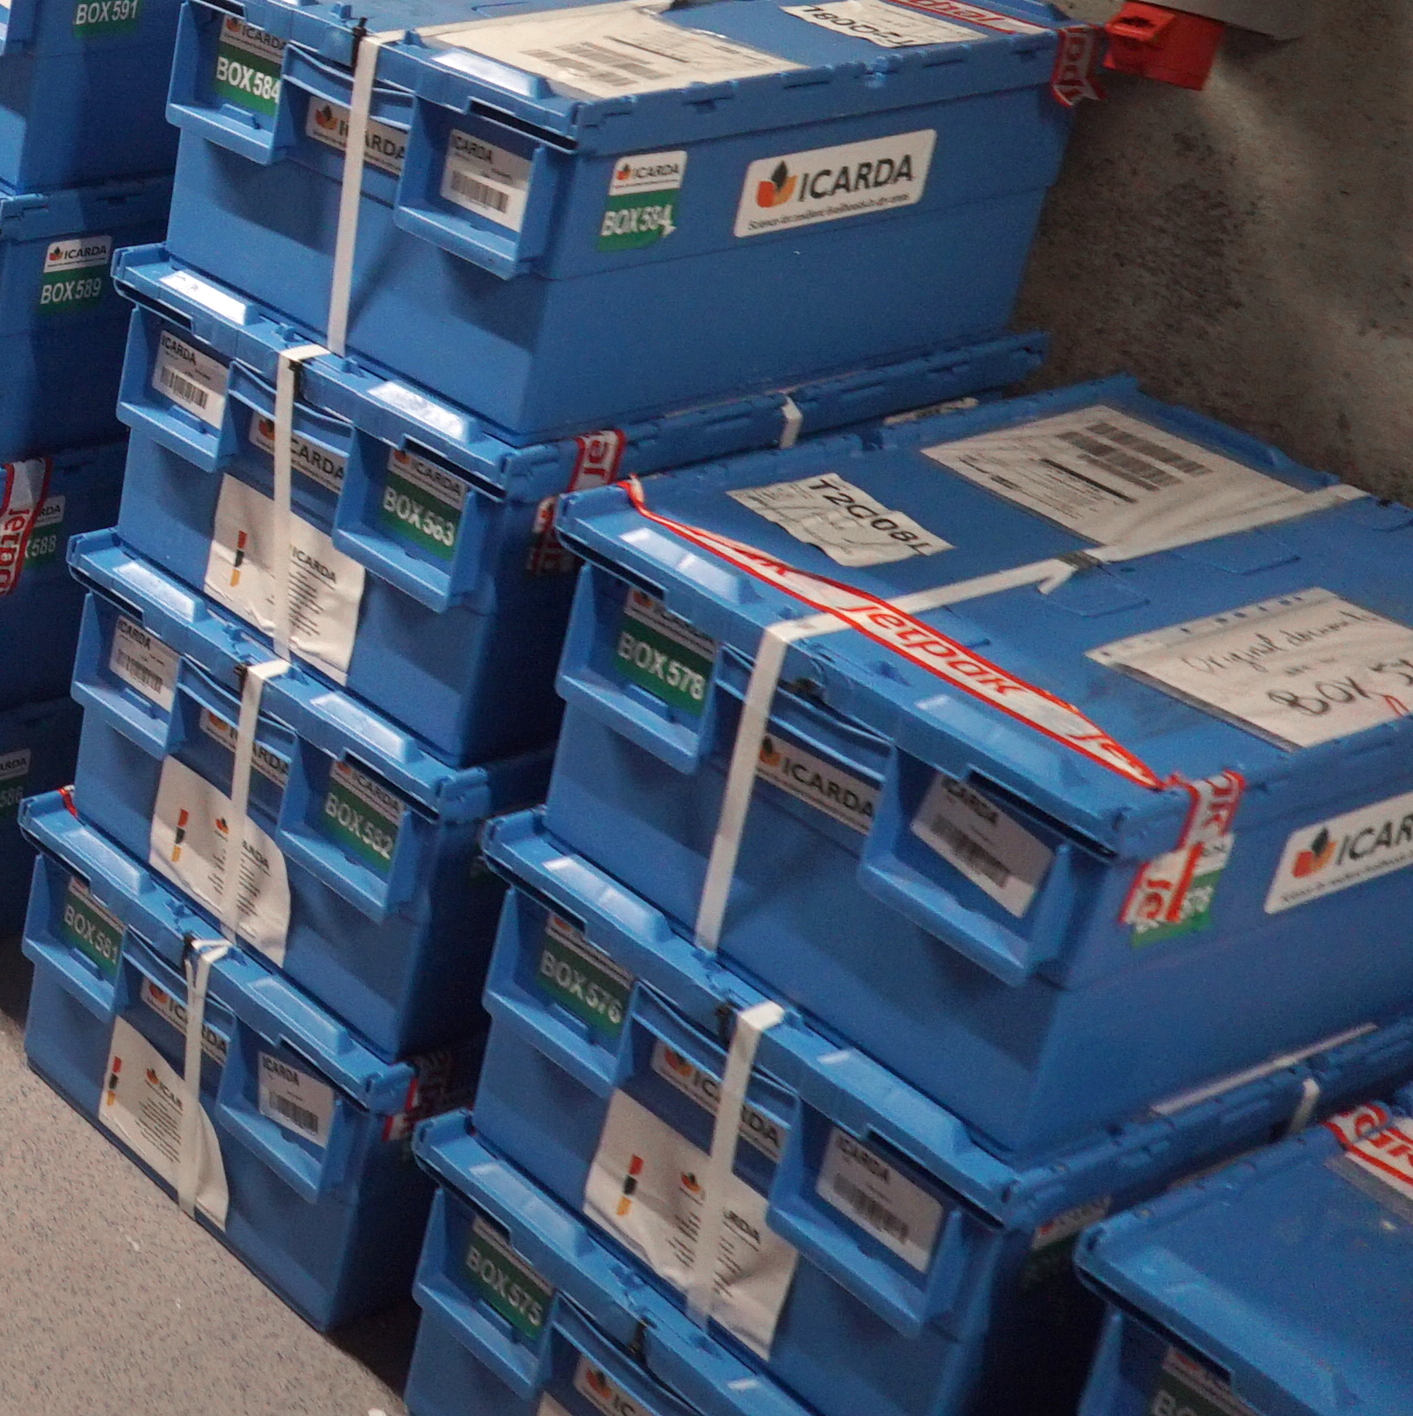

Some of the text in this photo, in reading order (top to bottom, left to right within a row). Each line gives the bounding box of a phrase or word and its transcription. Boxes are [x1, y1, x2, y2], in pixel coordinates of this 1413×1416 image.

[76, 0, 111, 25] BOX
[216, 55, 252, 93] BOX
[798, 154, 914, 202] ICARDA
[601, 207, 640, 236] BOX
[64, 245, 107, 261] ICARDA
[40, 278, 102, 305] BOX 589
[383, 485, 421, 526] BOX
[291, 546, 336, 584] ICARDA
[618, 632, 706, 700] BOX 578
[325, 792, 364, 838] BOX
[64, 904, 118, 965] BOX 581
[540, 949, 584, 1001] BOX
[465, 1244, 507, 1297] BOX
